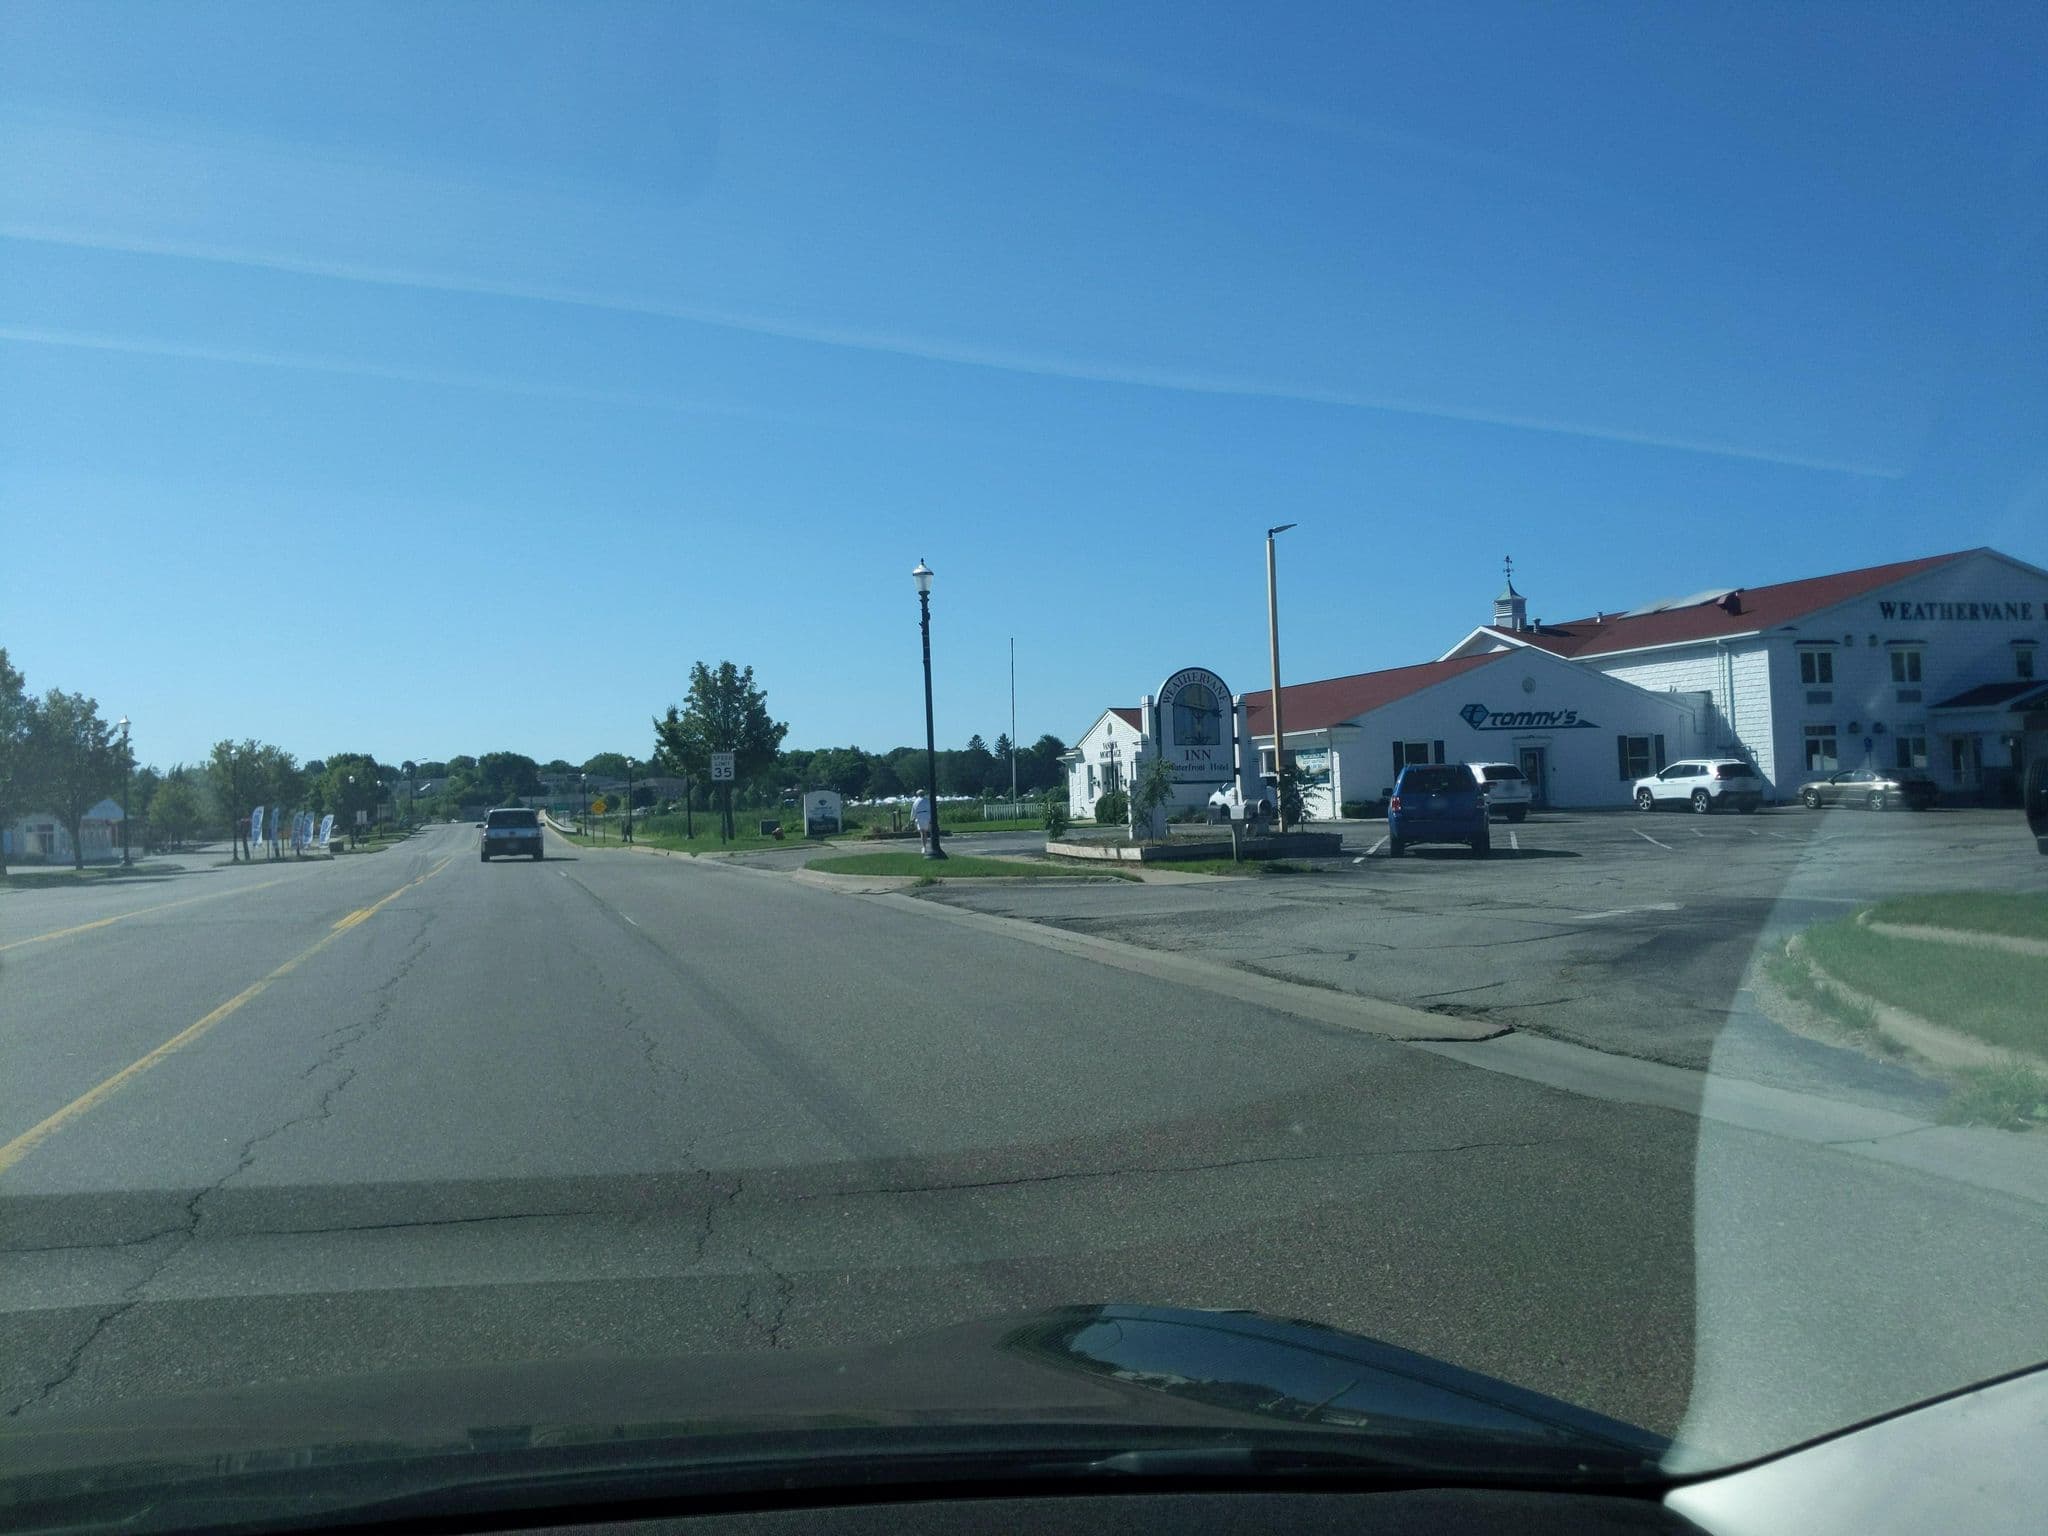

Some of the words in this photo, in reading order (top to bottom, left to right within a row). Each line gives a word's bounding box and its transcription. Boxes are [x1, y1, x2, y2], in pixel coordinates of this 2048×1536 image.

[1879, 601, 2033, 621] WEATHERVANE
[1162, 672, 1228, 704] WEATHERVANE
[1184, 749, 1212, 761] INN
[714, 767, 732, 778] 35
[1173, 762, 1206, 772] aterfront
